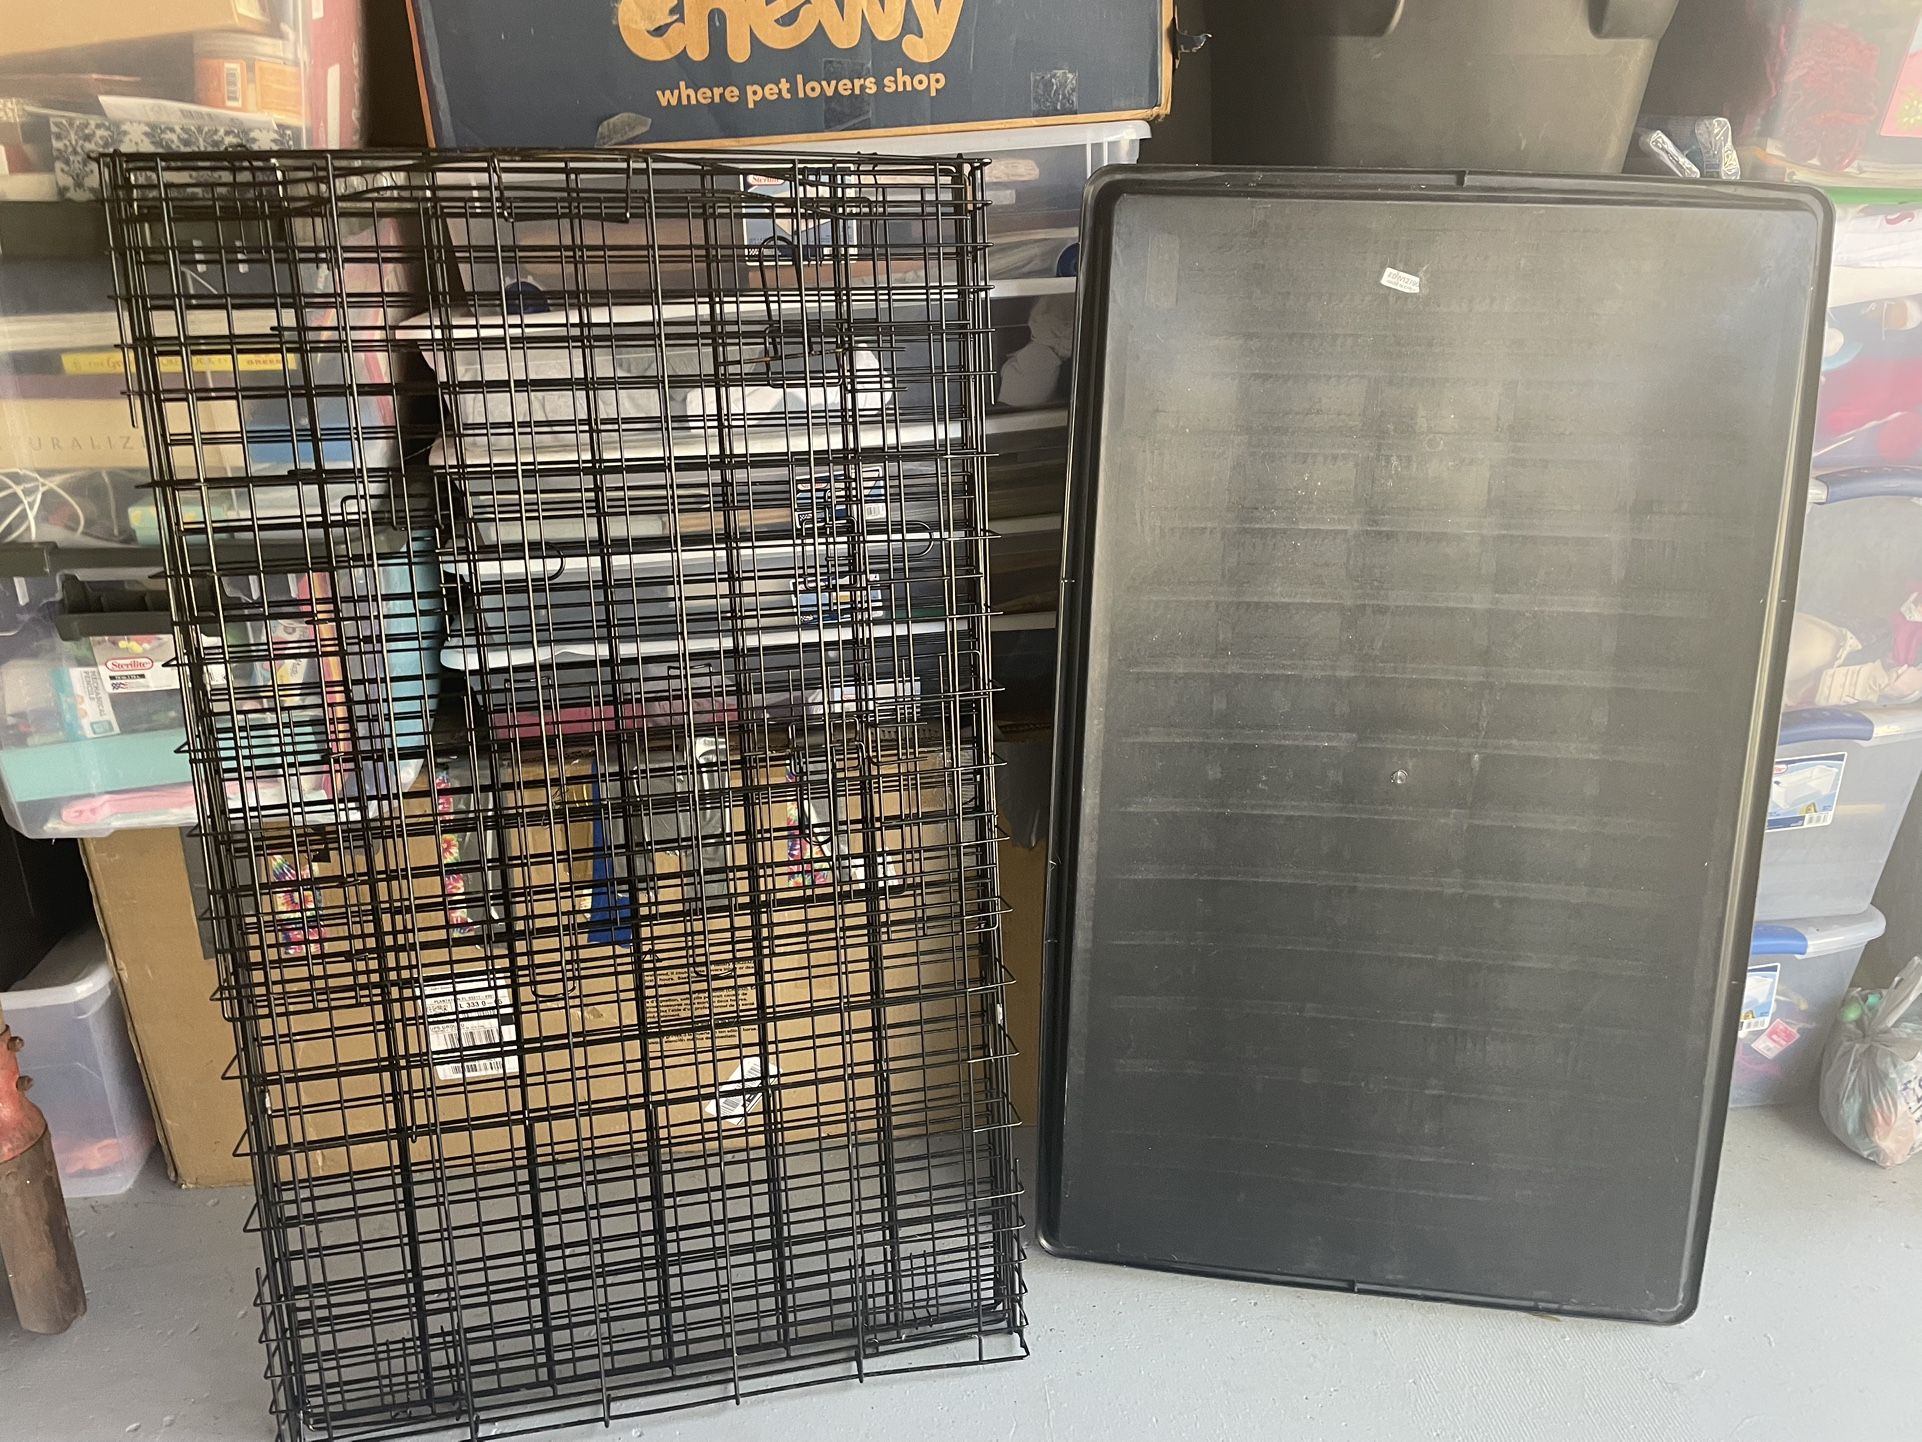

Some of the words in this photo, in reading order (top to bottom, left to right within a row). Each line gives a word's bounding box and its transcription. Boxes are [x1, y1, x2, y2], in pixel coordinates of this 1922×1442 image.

[656, 80, 740, 107] where
[746, 77, 792, 109] pet
[796, 74, 877, 99] lovers
[883, 67, 946, 97] shop
[111, 660, 147, 669] Sterilite
